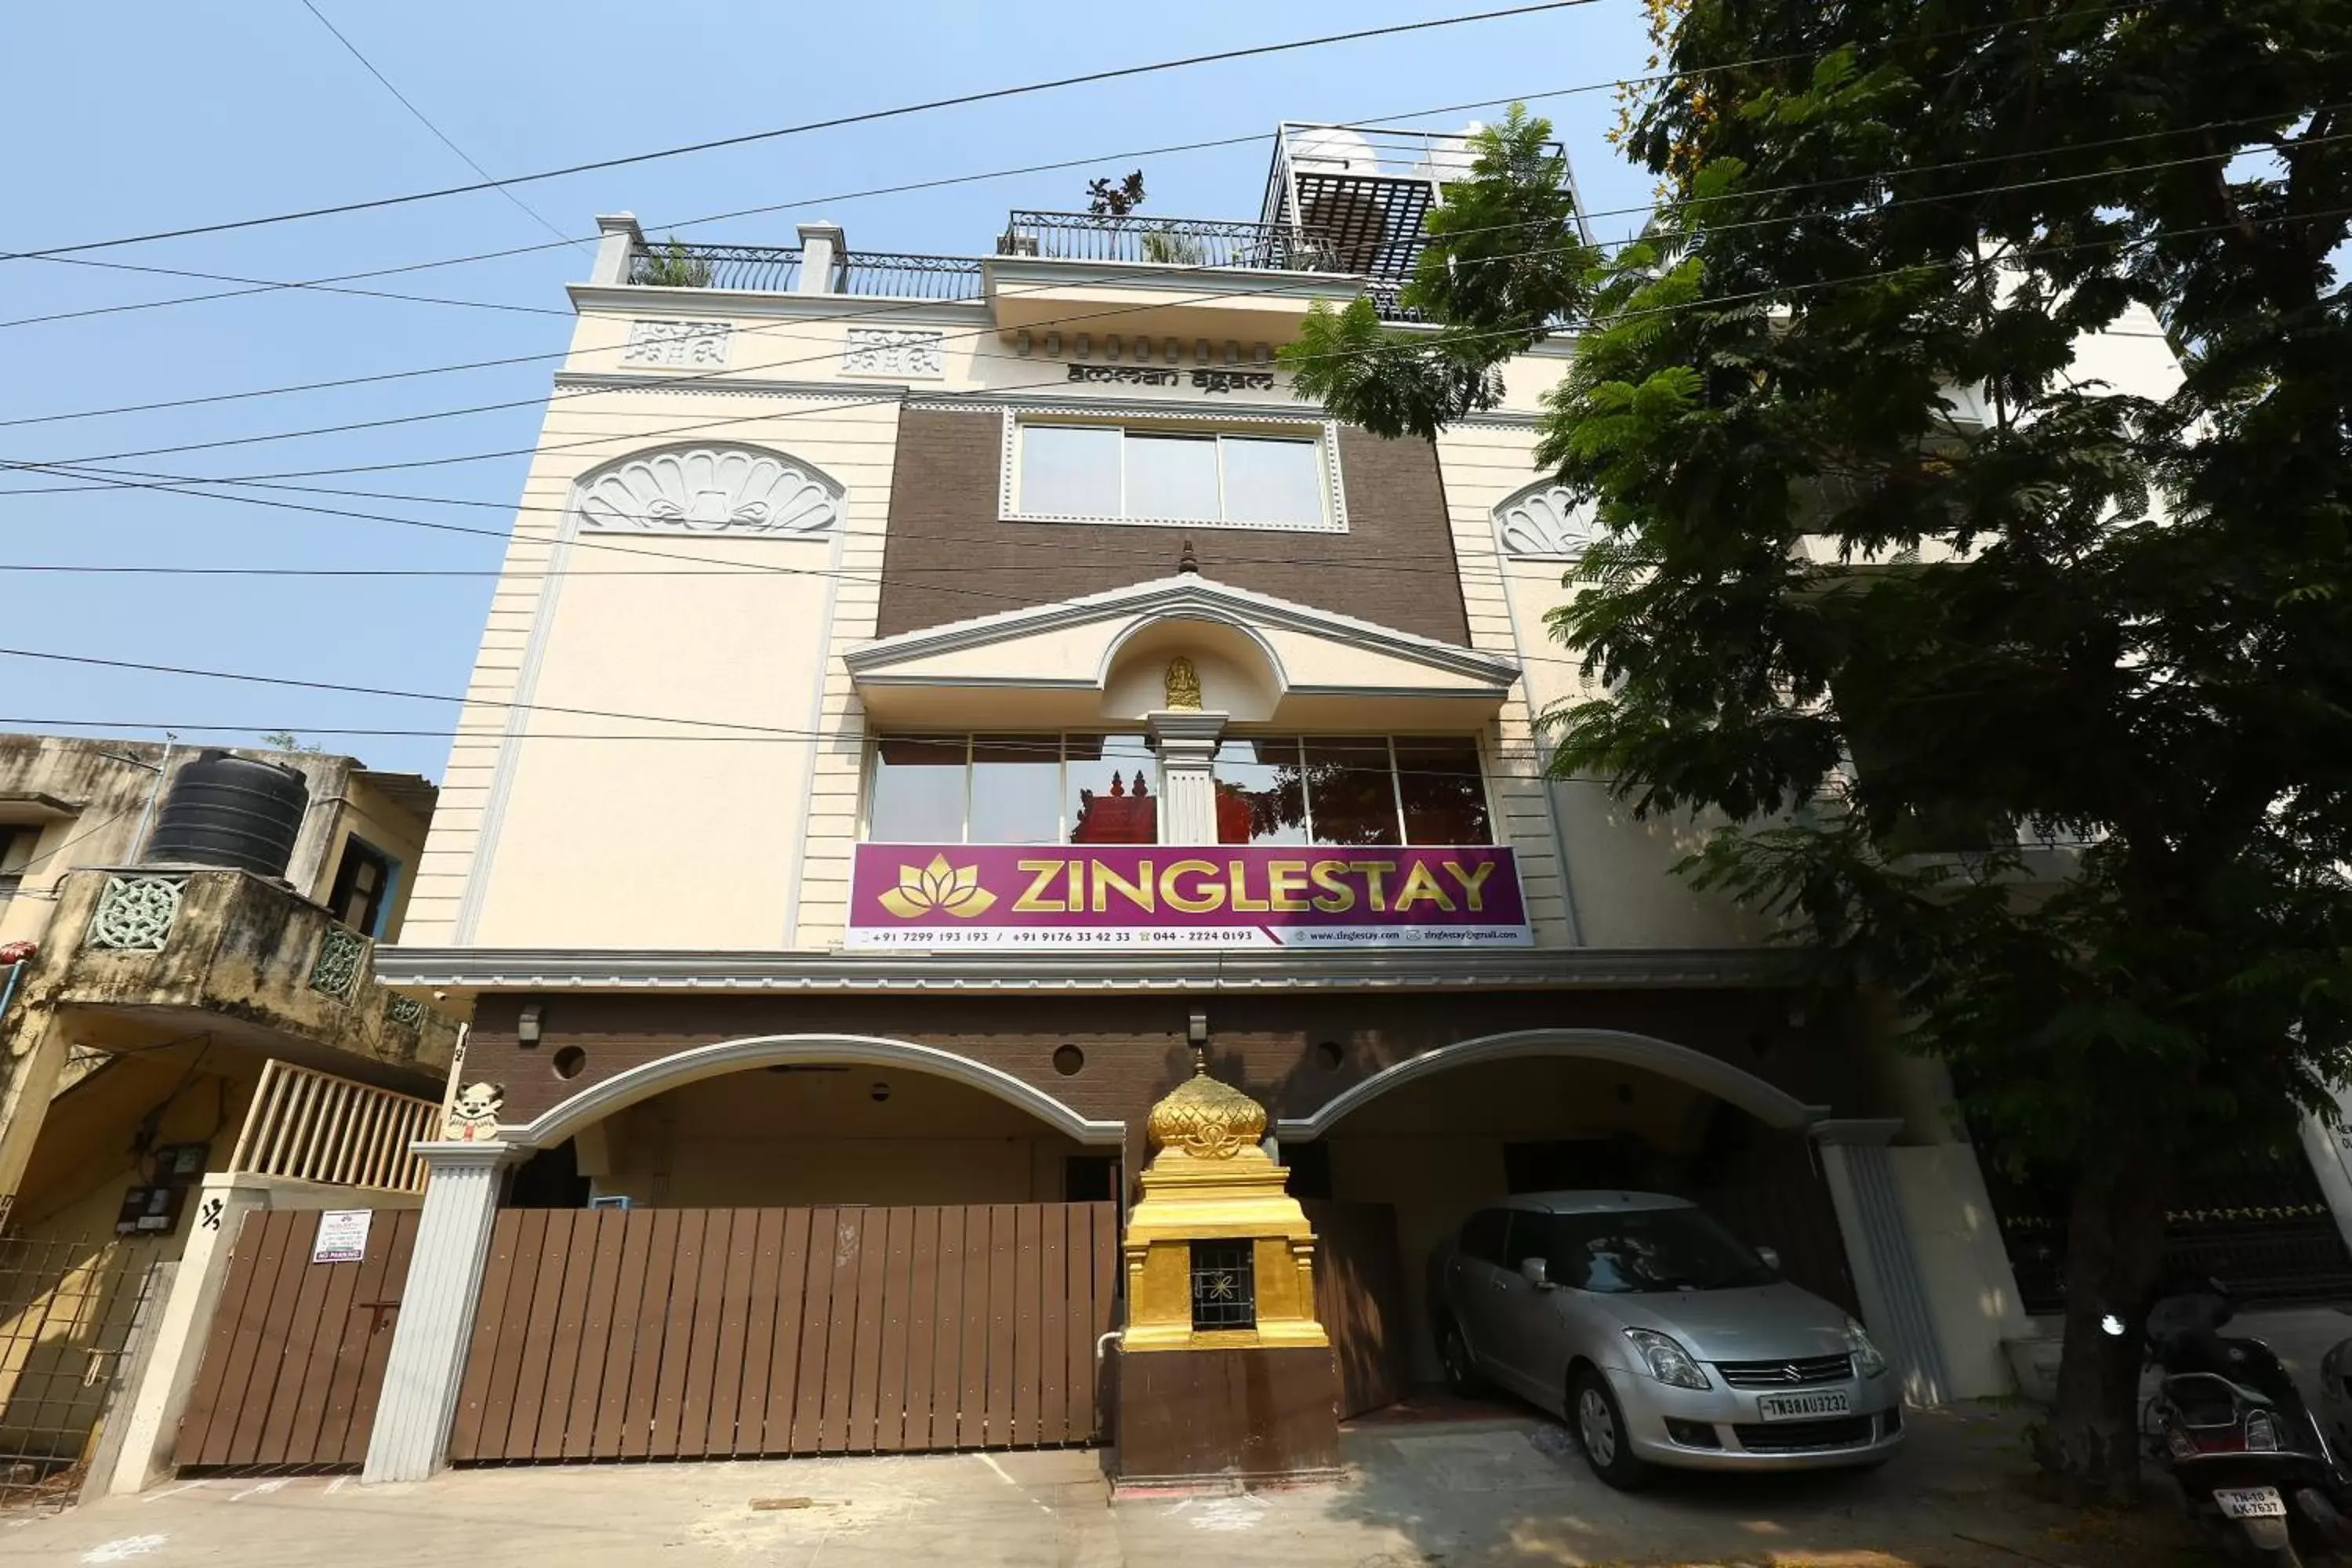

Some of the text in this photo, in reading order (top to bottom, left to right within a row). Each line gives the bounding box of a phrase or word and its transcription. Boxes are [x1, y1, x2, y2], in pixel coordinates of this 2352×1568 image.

[1011, 858, 1495, 913] ZINGLESTAY
[873, 932, 897, 942] +91
[903, 932, 933, 942] 7299
[939, 932, 960, 942] 193
[967, 932, 989, 942] 193
[1013, 932, 1036, 942] +91
[1042, 932, 1072, 942] 9176
[1076, 932, 1091, 942] 33
[1095, 932, 1111, 942] 42
[1116, 932, 1131, 942] 33
[1153, 931, 1176, 941] 044
[1189, 931, 1218, 941] 2224
[1222, 931, 1252, 940] 0193
[1769, 1395, 1849, 1415] TN38AU3232
